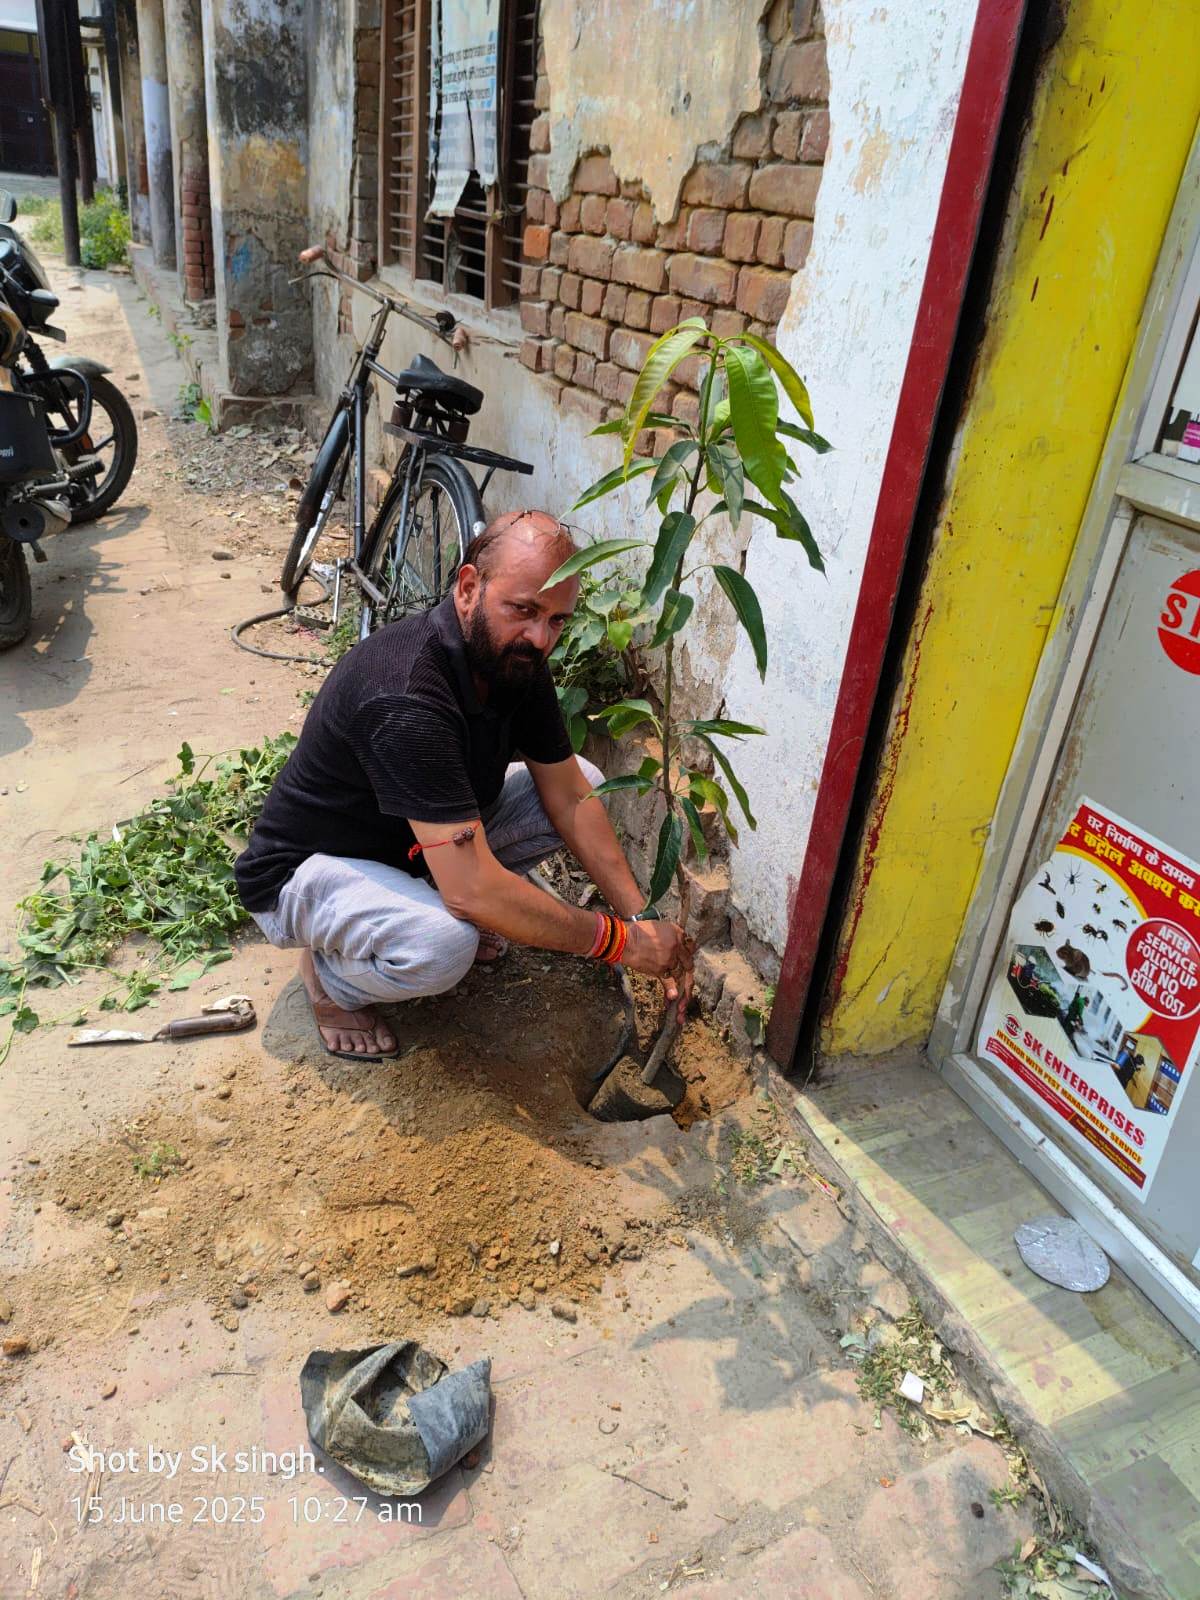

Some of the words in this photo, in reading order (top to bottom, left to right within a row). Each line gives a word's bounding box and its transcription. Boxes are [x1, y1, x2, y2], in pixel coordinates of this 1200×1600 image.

[1087, 815, 1104, 832] घर
[1105, 824, 1144, 857] निर्माण
[1144, 849, 1160, 866] के
[1161, 860, 1196, 889] समय
[1144, 932, 1197, 975] SERVICE
[1158, 925, 1191, 955] AFTER
[1136, 940, 1180, 978] FOLLOW
[1180, 971, 1198, 990] UP
[1140, 960, 1158, 979] AT
[1158, 971, 1179, 995] NO
[1131, 968, 1158, 999] EXTRA
[1160, 991, 1185, 1016] COST
[1023, 1031, 1043, 1057] SK
[1044, 1049, 1145, 1146] ENTERPRISES
[1061, 1087, 1108, 1135] MANAGEMENT
[1110, 1131, 1142, 1164] SERVICE
